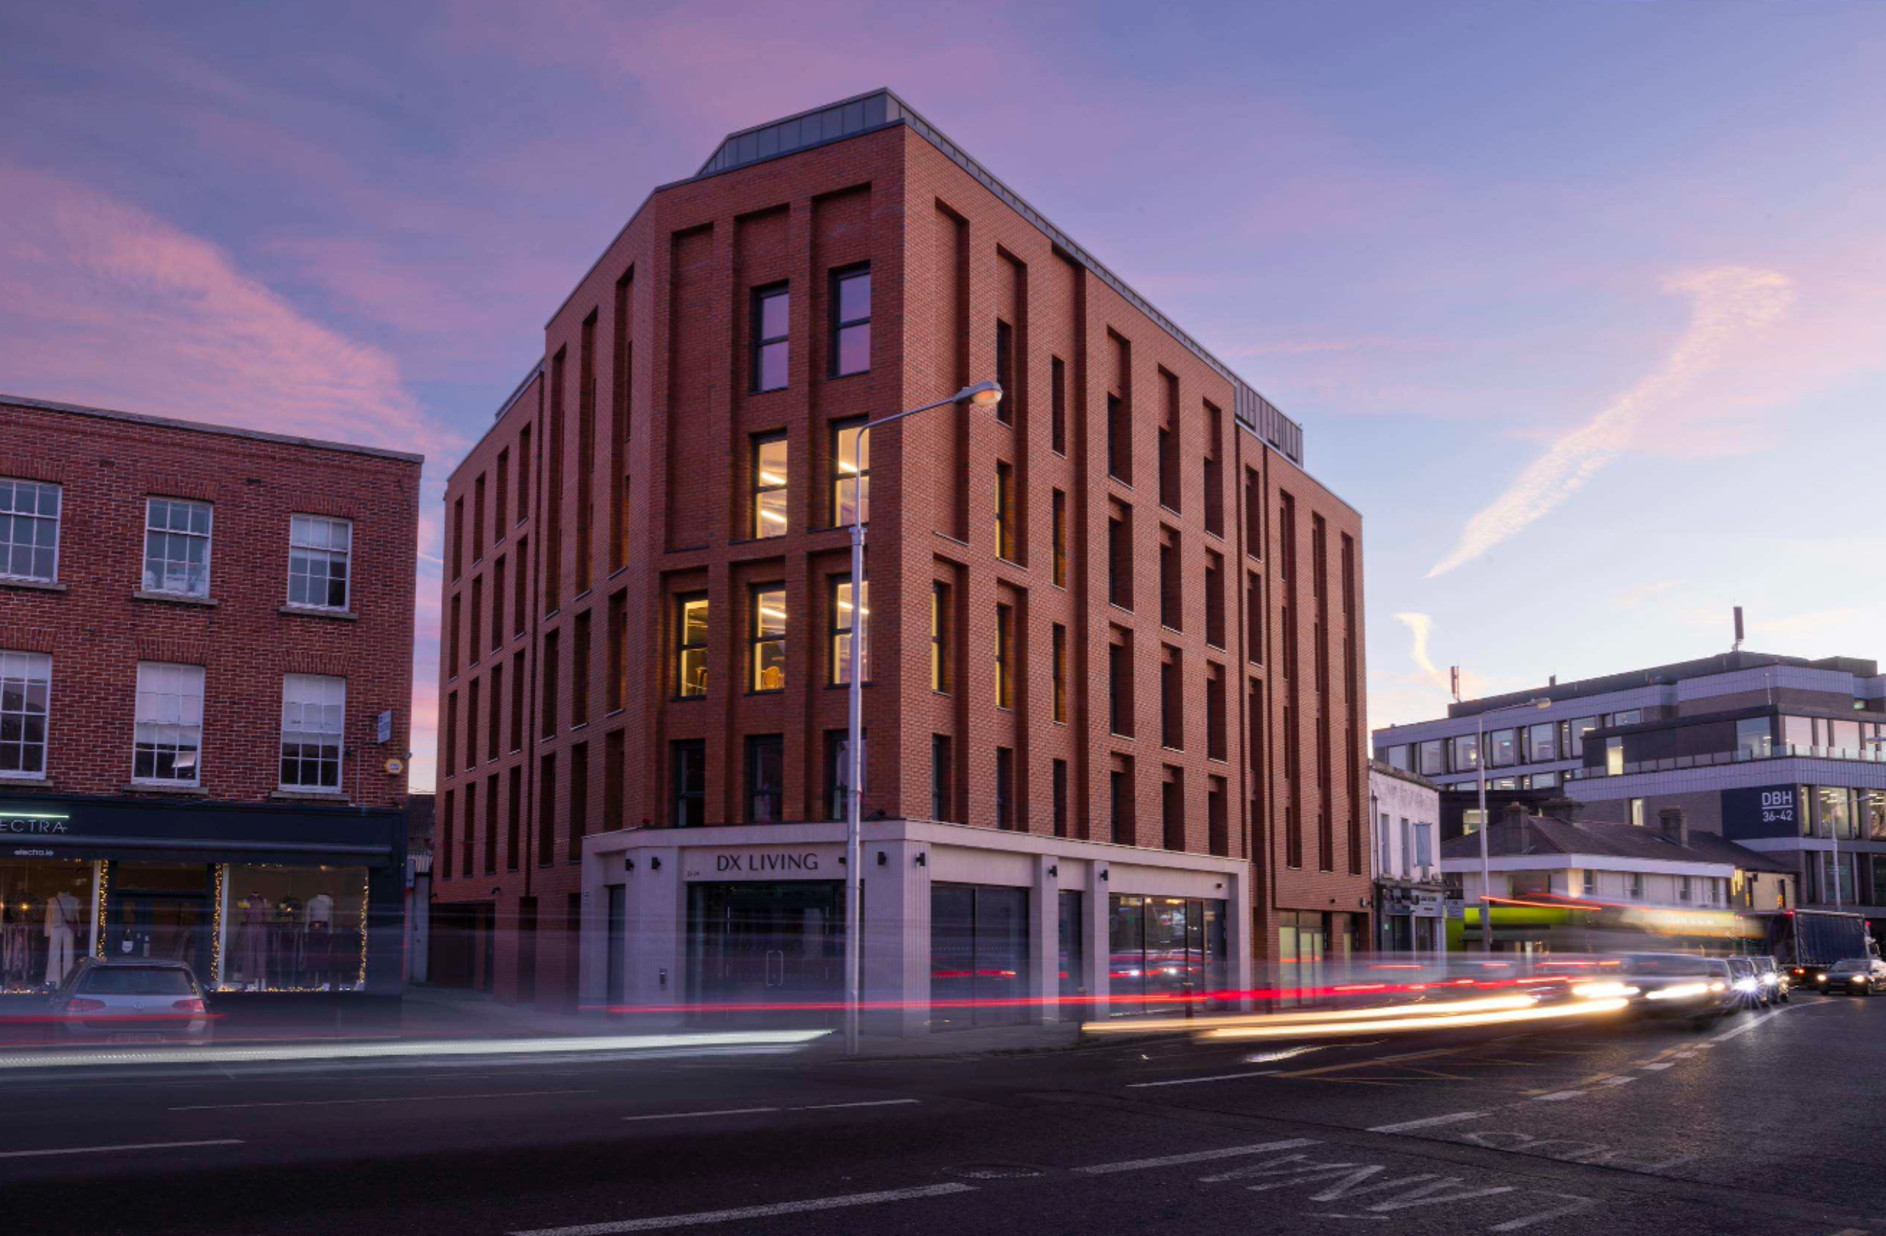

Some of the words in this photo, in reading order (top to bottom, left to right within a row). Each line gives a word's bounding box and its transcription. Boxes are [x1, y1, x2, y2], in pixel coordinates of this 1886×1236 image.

[1762, 790, 1792, 806] DBH
[1762, 810, 1793, 822] 36-42
[0, 818, 68, 833] ECTRA
[717, 854, 742, 871] DX
[749, 852, 818, 871] LIVING
